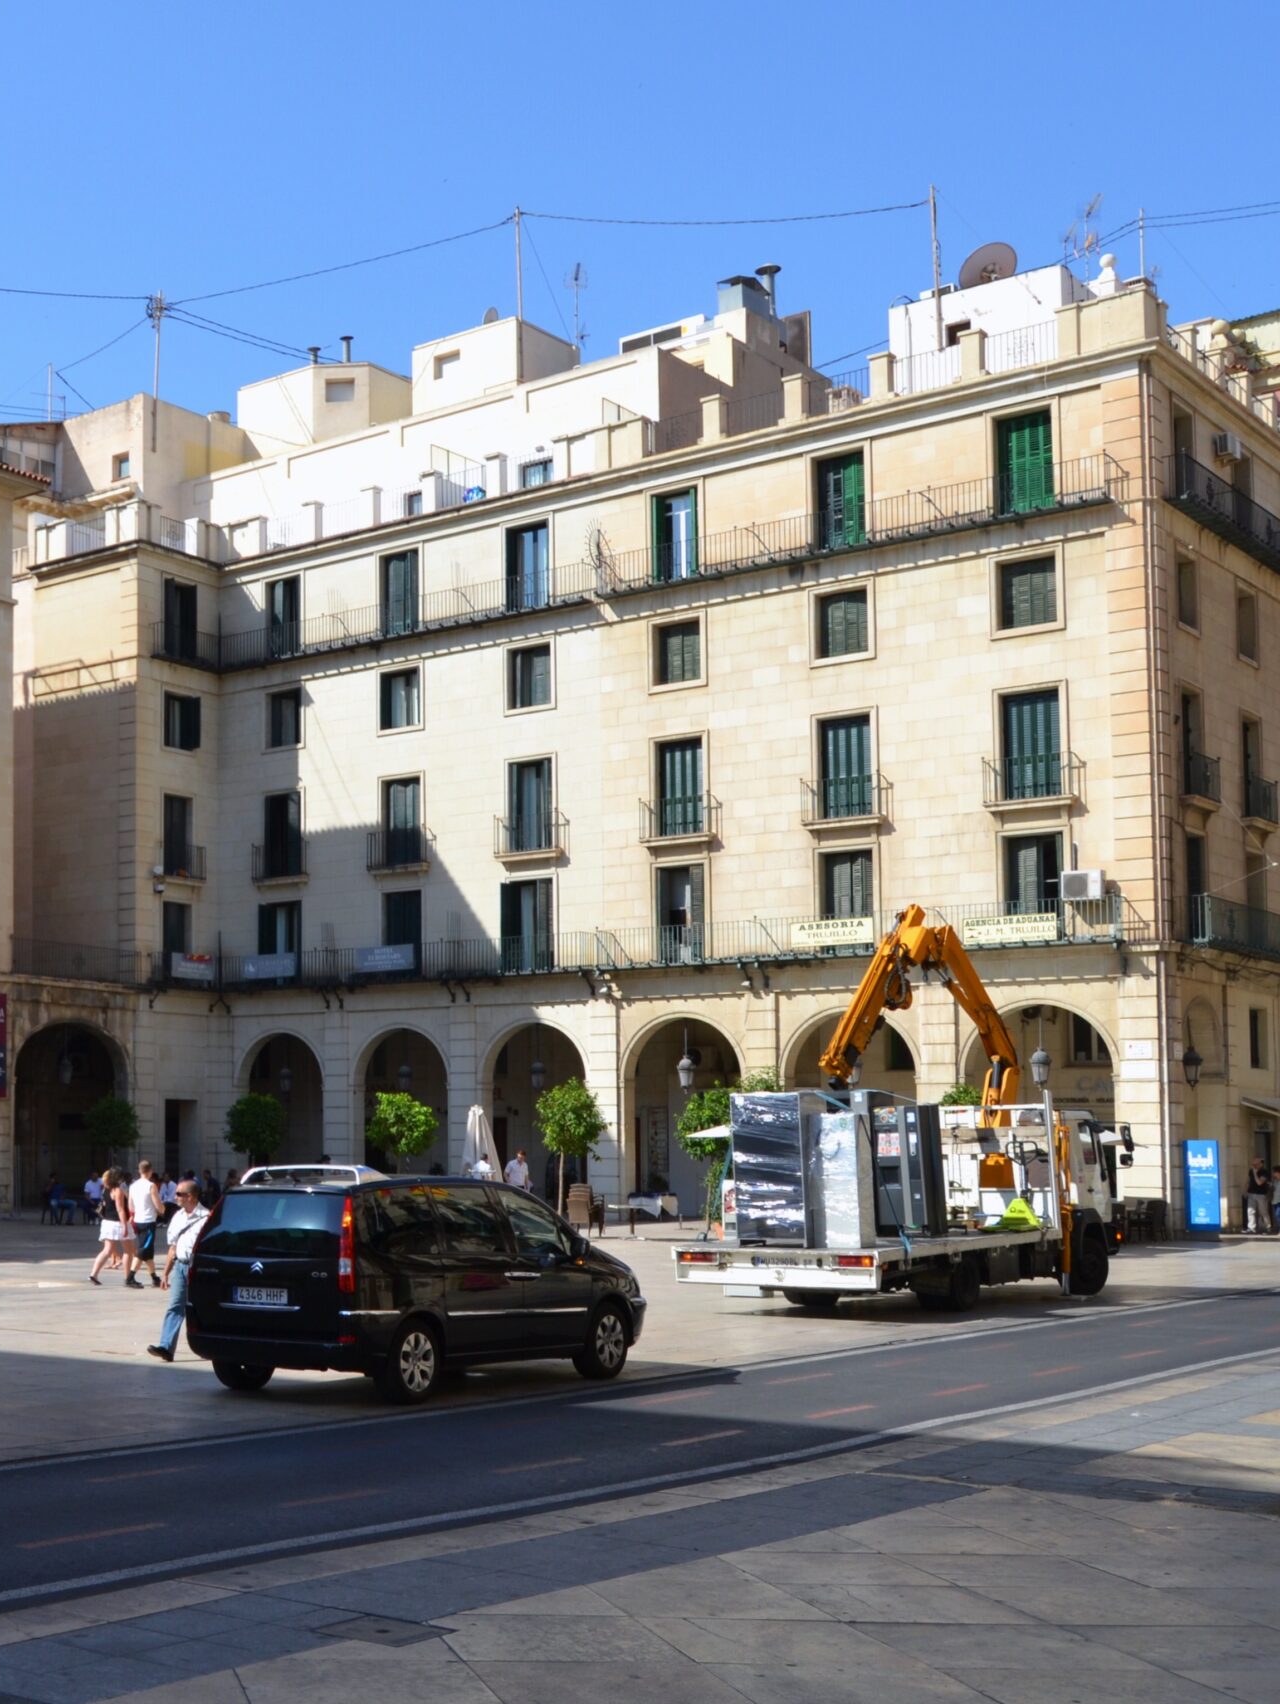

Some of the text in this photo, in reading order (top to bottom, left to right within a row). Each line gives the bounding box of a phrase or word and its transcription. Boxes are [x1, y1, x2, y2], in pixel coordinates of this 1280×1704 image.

[799, 920, 864, 931] ASESORIA
[965, 915, 1055, 927] AGENCIA DE ADUANAS
[807, 929, 858, 939] TRUJILLO
[1010, 925, 1056, 934] TRUJILLO
[239, 1288, 285, 1302] 4346 HHF
